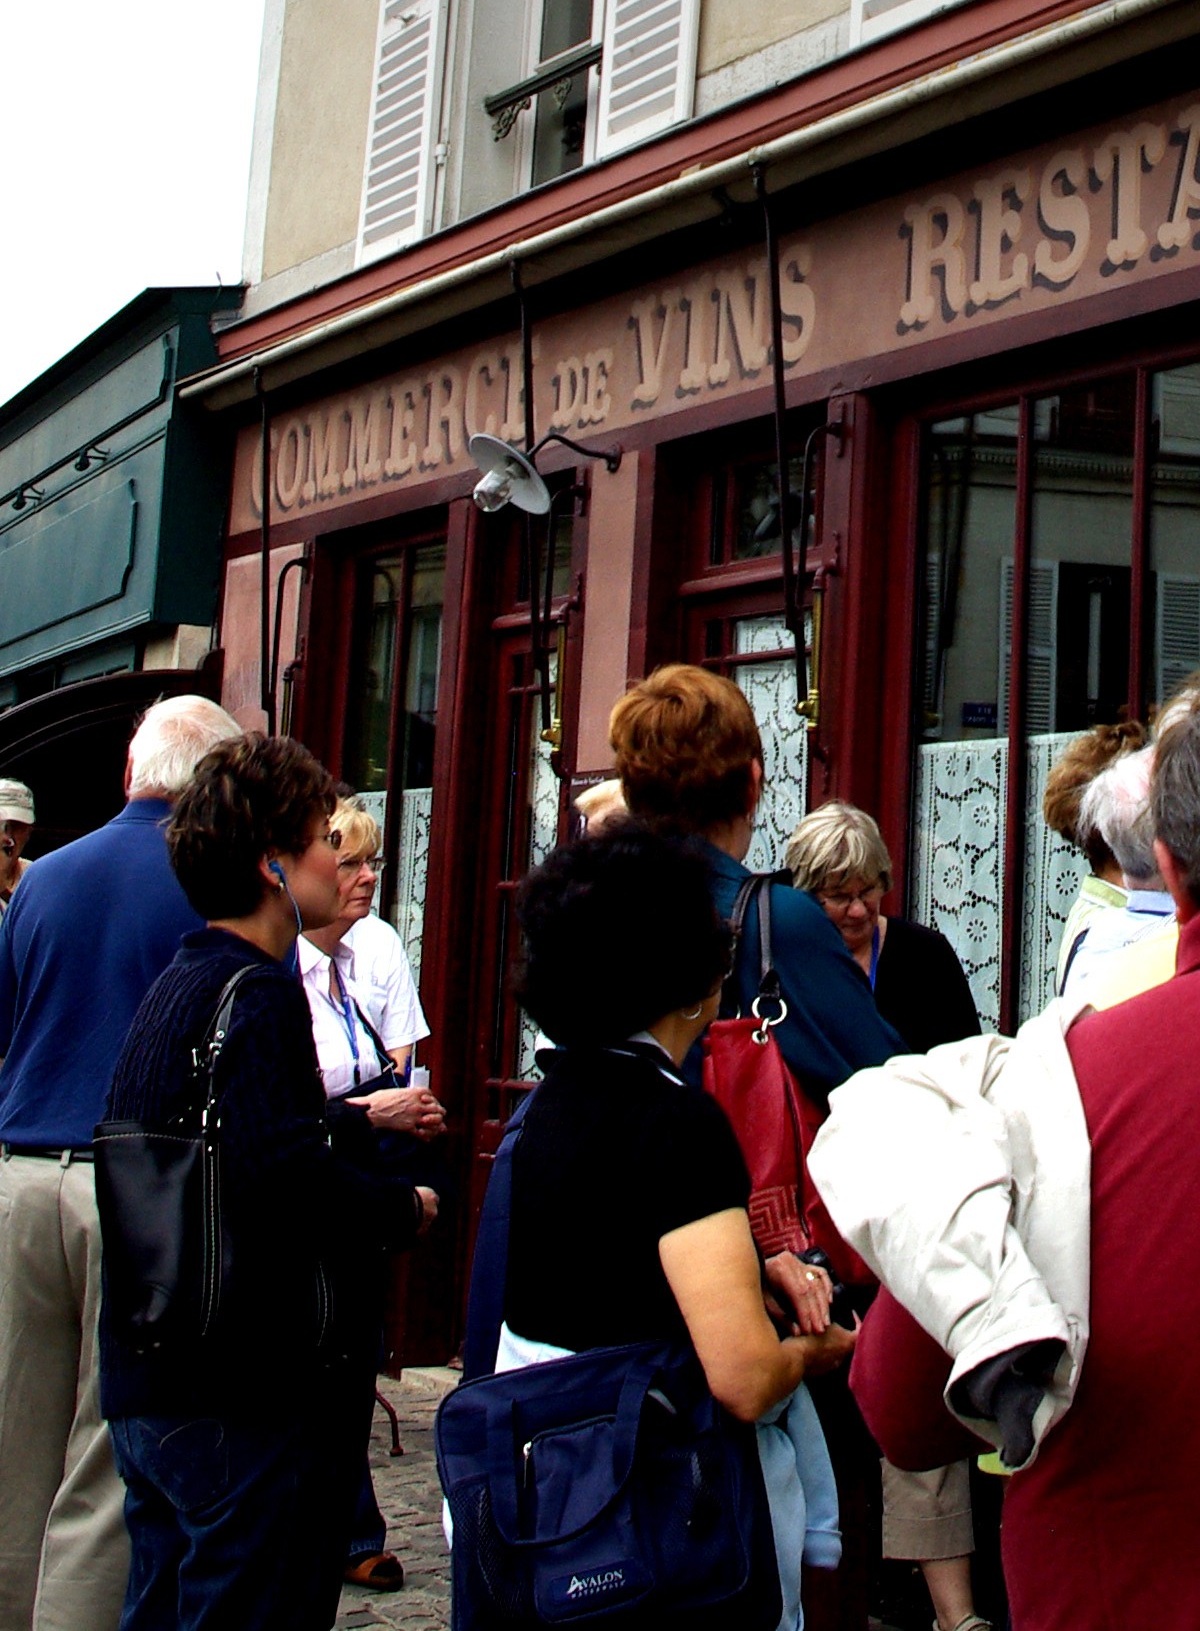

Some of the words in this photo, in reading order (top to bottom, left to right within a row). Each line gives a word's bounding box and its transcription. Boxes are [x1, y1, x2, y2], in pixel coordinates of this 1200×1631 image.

[549, 347, 613, 434] DE
[627, 243, 816, 411] VINS
[566, 1569, 624, 1595] AVALON
